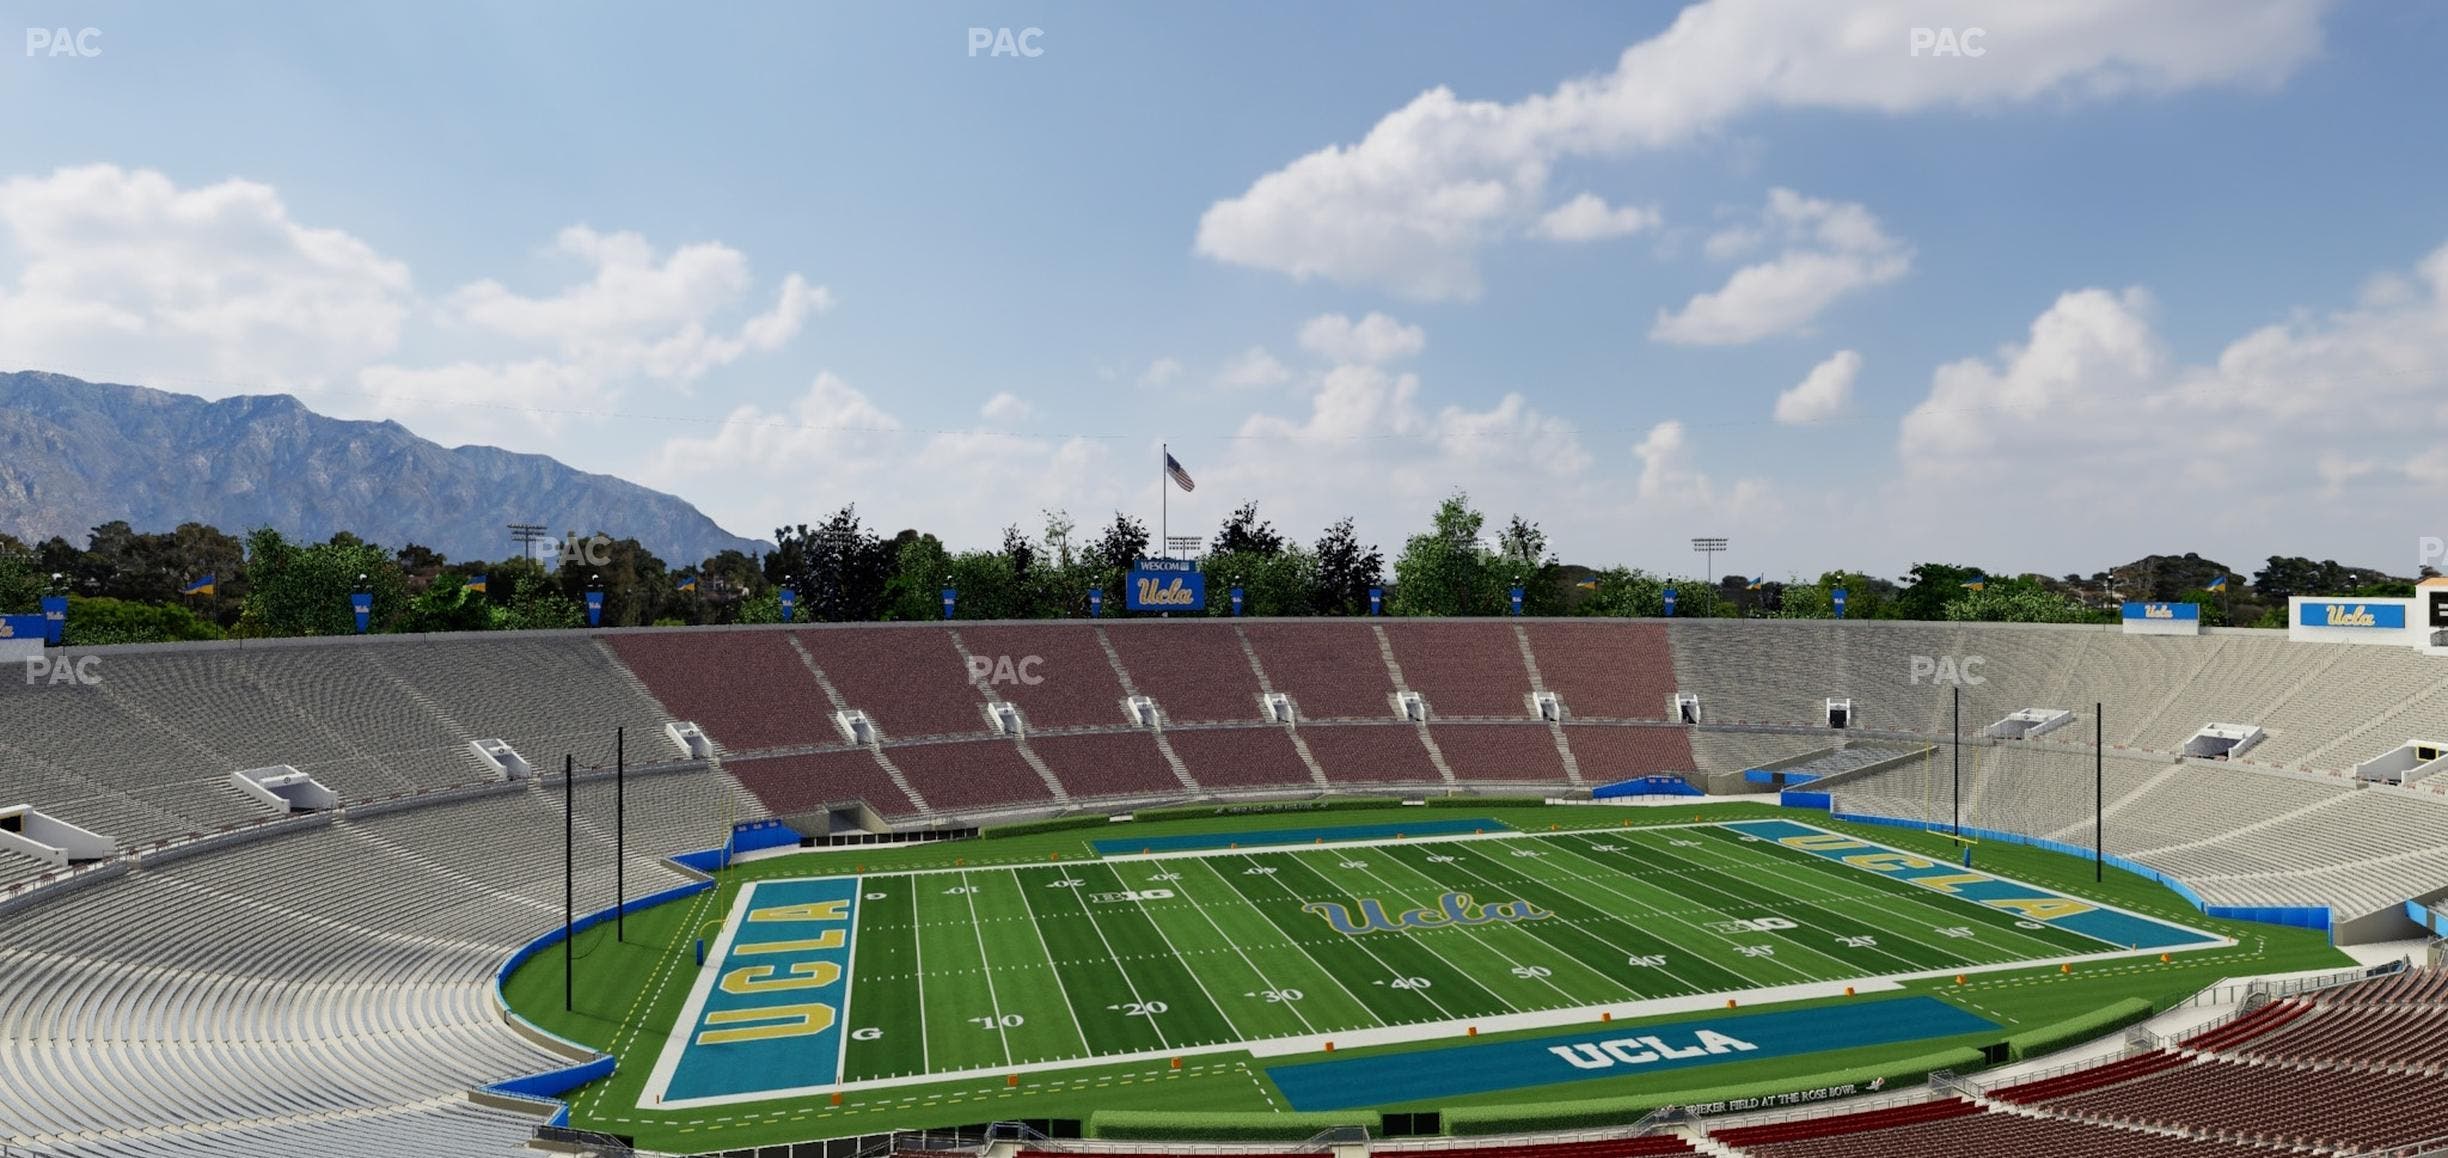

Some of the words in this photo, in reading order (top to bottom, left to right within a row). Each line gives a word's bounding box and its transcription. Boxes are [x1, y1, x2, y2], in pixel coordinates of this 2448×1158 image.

[1140, 561, 1180, 571] WESCOM
[1137, 577, 1195, 605] Ucla
[2325, 604, 2376, 626] Ucla
[1777, 834, 2100, 921] UCLA
[1301, 891, 1554, 935] Ucla
[695, 899, 850, 1045] UCLA
[1510, 965, 1552, 979] 50
[1390, 976, 1432, 990] 40
[1260, 988, 1304, 1003] 30
[1121, 1001, 1168, 1016] 20
[980, 1014, 1025, 1030] 10
[851, 1027, 884, 1041] G
[1547, 1029, 1759, 1069] UCLA
[1729, 1097, 1759, 1111] FIELD
[1761, 1095, 1776, 1107] AT
[1777, 1092, 1800, 1105] THE
[1801, 1087, 1828, 1102] ROSE
[1829, 1084, 1857, 1098] BOWL
